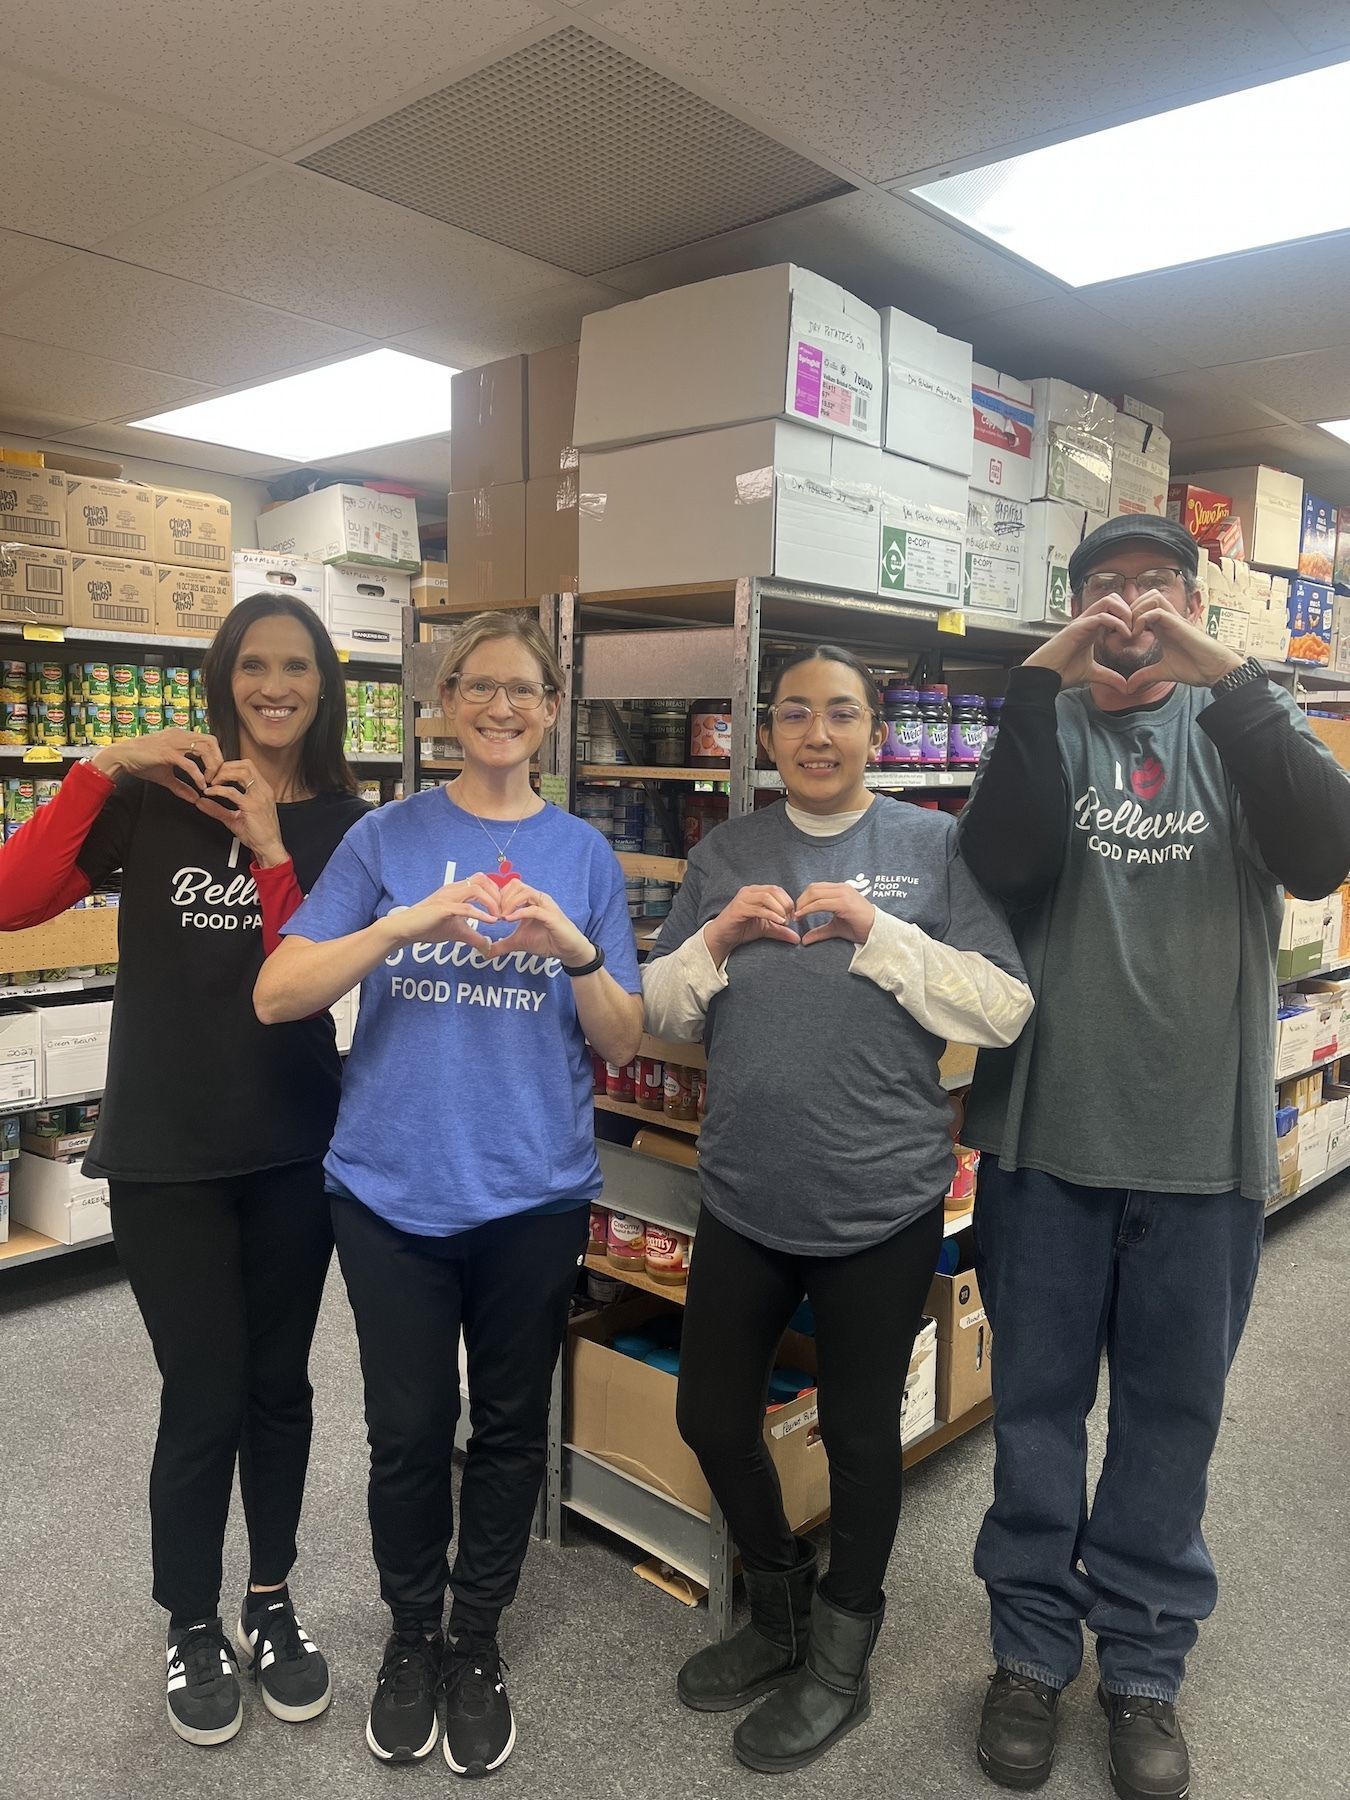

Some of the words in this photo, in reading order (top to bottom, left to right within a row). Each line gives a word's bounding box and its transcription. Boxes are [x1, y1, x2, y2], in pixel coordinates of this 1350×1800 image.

[83, 505, 104, 520] Chips
[169, 518, 188, 533] Chips
[87, 580, 107, 595] Chips
[172, 591, 190, 604] Chips
[1114, 761, 1124, 791] I
[1087, 835, 1123, 860] OOD
[1126, 843, 1195, 864] PANTRY
[874, 875, 920, 885] BELLEVUE
[872, 890, 908, 898] PANTRY
[181, 912, 238, 930] FOOD
[391, 976, 452, 1003] FOOD
[456, 982, 547, 1012] PANTRY
[47, 1040, 70, 1049] Green
[613, 1220, 640, 1232] Creamy
